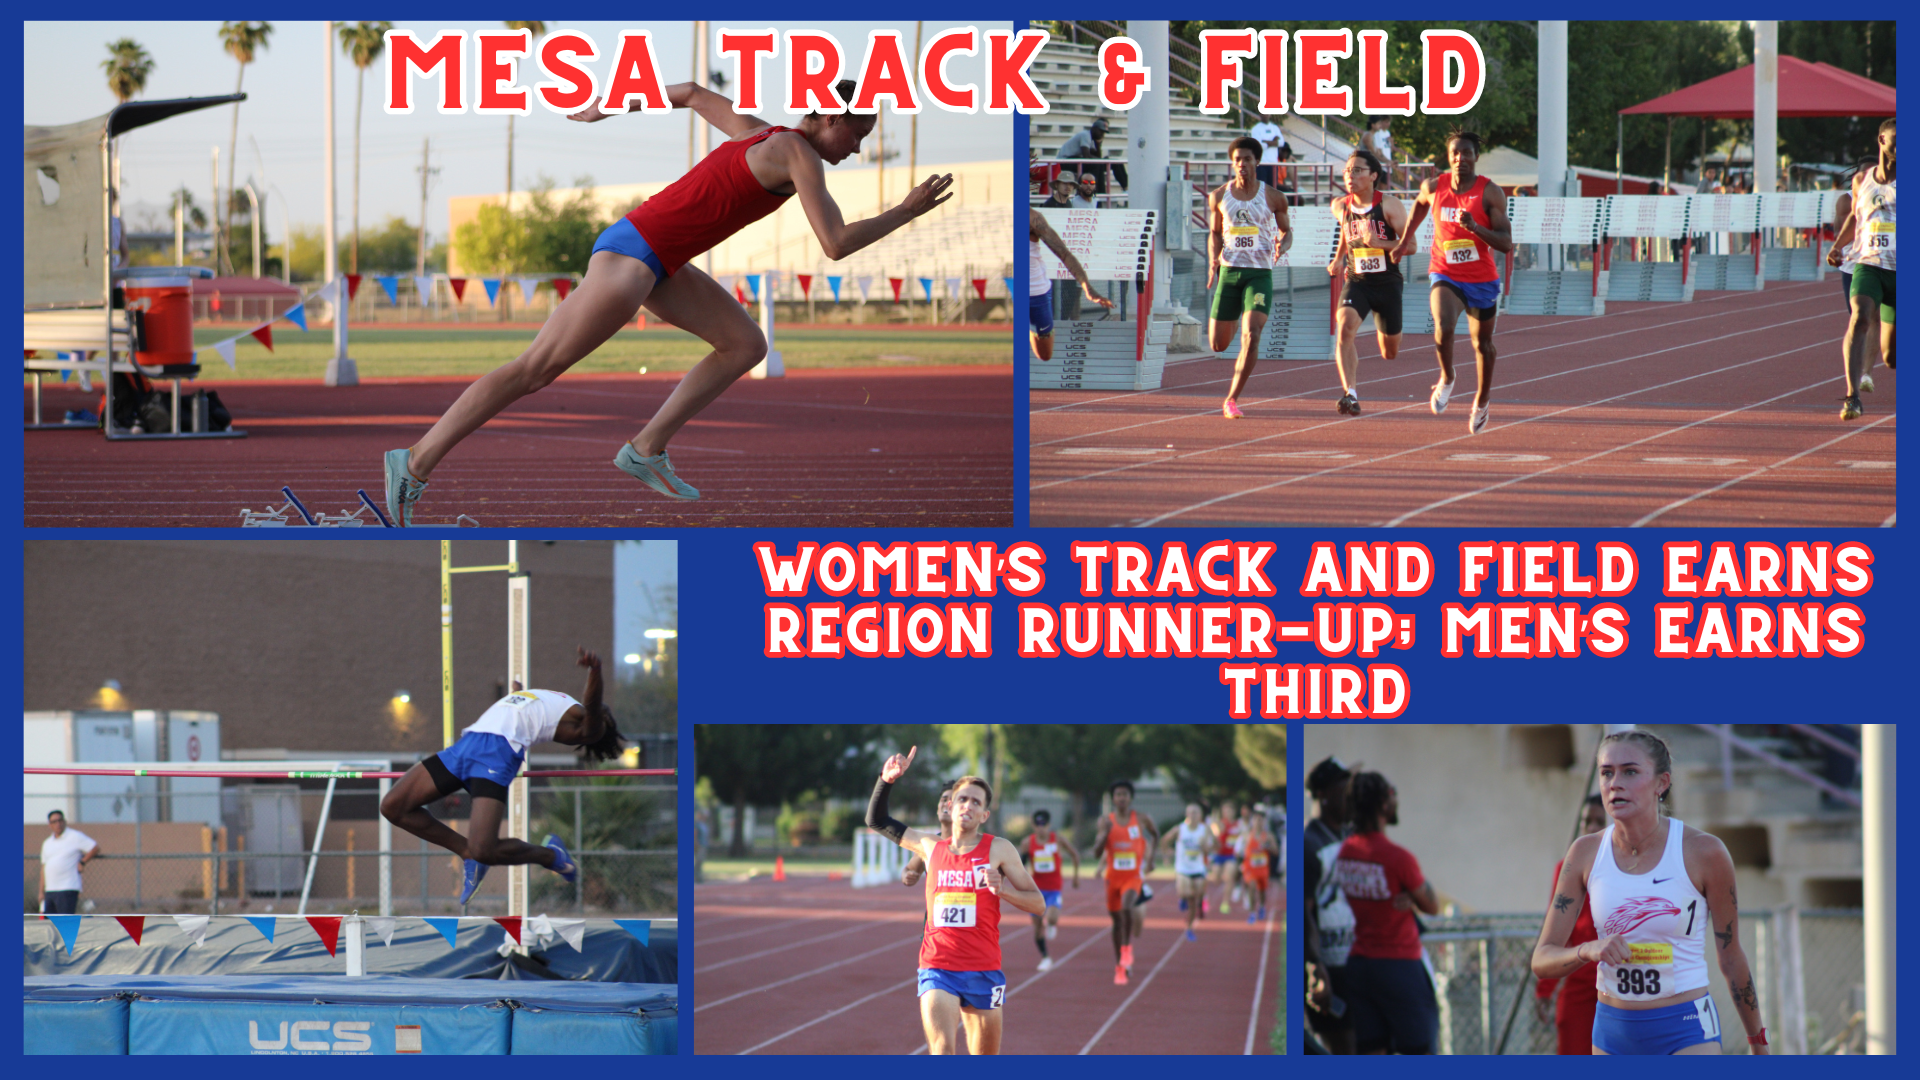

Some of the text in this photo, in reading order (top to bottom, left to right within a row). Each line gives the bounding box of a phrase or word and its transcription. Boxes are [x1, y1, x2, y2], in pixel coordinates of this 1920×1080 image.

[1234, 236, 1254, 248] 365
[1868, 234, 1890, 247] 355
[1452, 249, 1474, 262] 432
[398, 476, 408, 504] HOKA
[938, 870, 973, 888] MESA
[977, 866, 988, 888] 2
[941, 907, 966, 924] 421
[1685, 900, 1697, 936] 1
[1616, 968, 1661, 996] 393
[994, 987, 1002, 1006] 2
[1703, 998, 1716, 1034] 1
[250, 1020, 372, 1052] UCS
